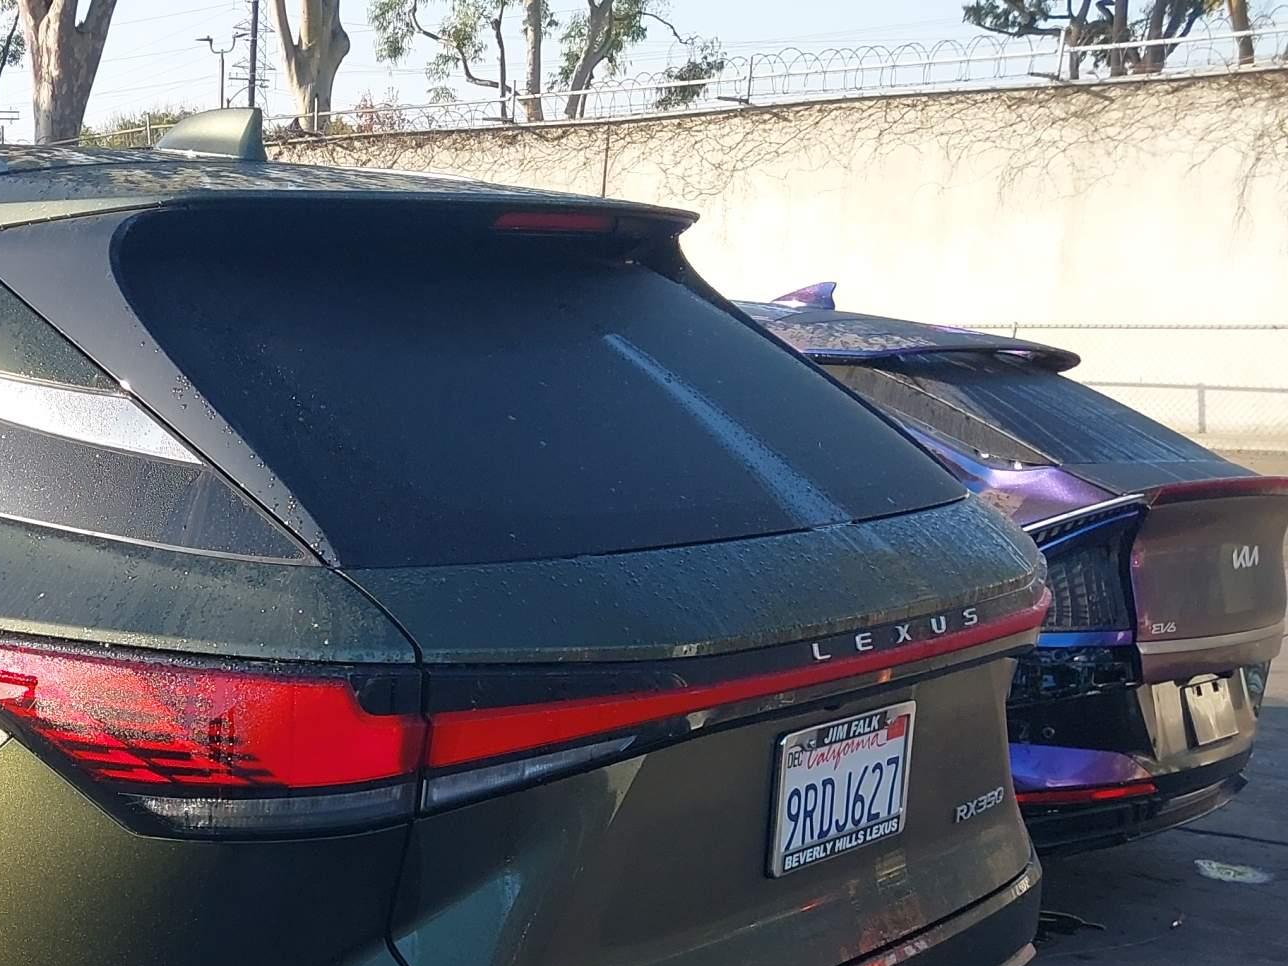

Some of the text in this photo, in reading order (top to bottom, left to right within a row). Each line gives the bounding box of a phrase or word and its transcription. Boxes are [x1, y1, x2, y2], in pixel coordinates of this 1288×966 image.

[812, 607, 978, 661] LEXUS
[1151, 621, 1177, 635] EV6
[823, 714, 881, 744] JIM FALK
[787, 751, 804, 769] DEC
[807, 731, 887, 771] California
[784, 755, 900, 852] 9RDJ627
[784, 818, 899, 871] BEVERLY HILLS LEXUS
